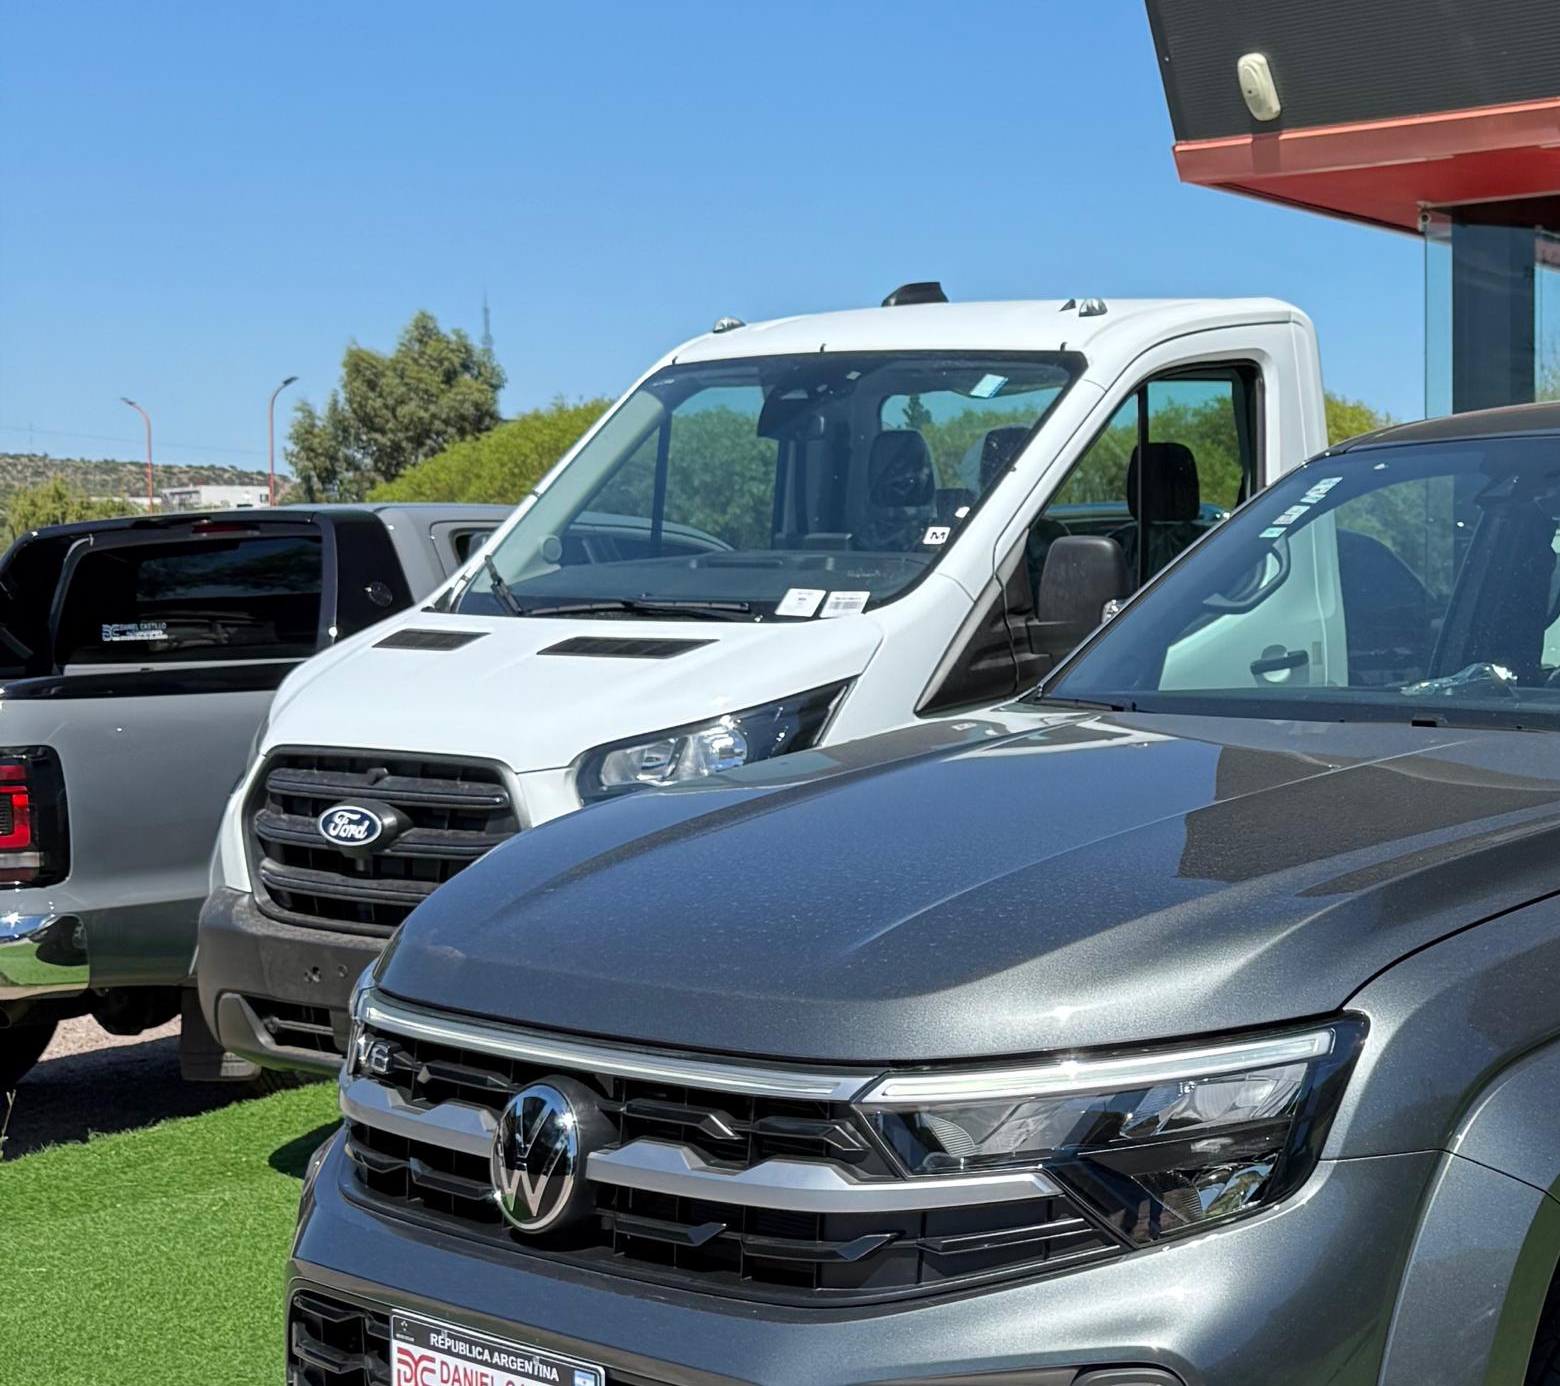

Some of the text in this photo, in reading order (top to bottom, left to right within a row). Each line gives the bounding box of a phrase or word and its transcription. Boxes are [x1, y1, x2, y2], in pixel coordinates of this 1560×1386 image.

[328, 811, 370, 839] Ford
[430, 1333, 560, 1382] REPUBLICA ARGENTINA
